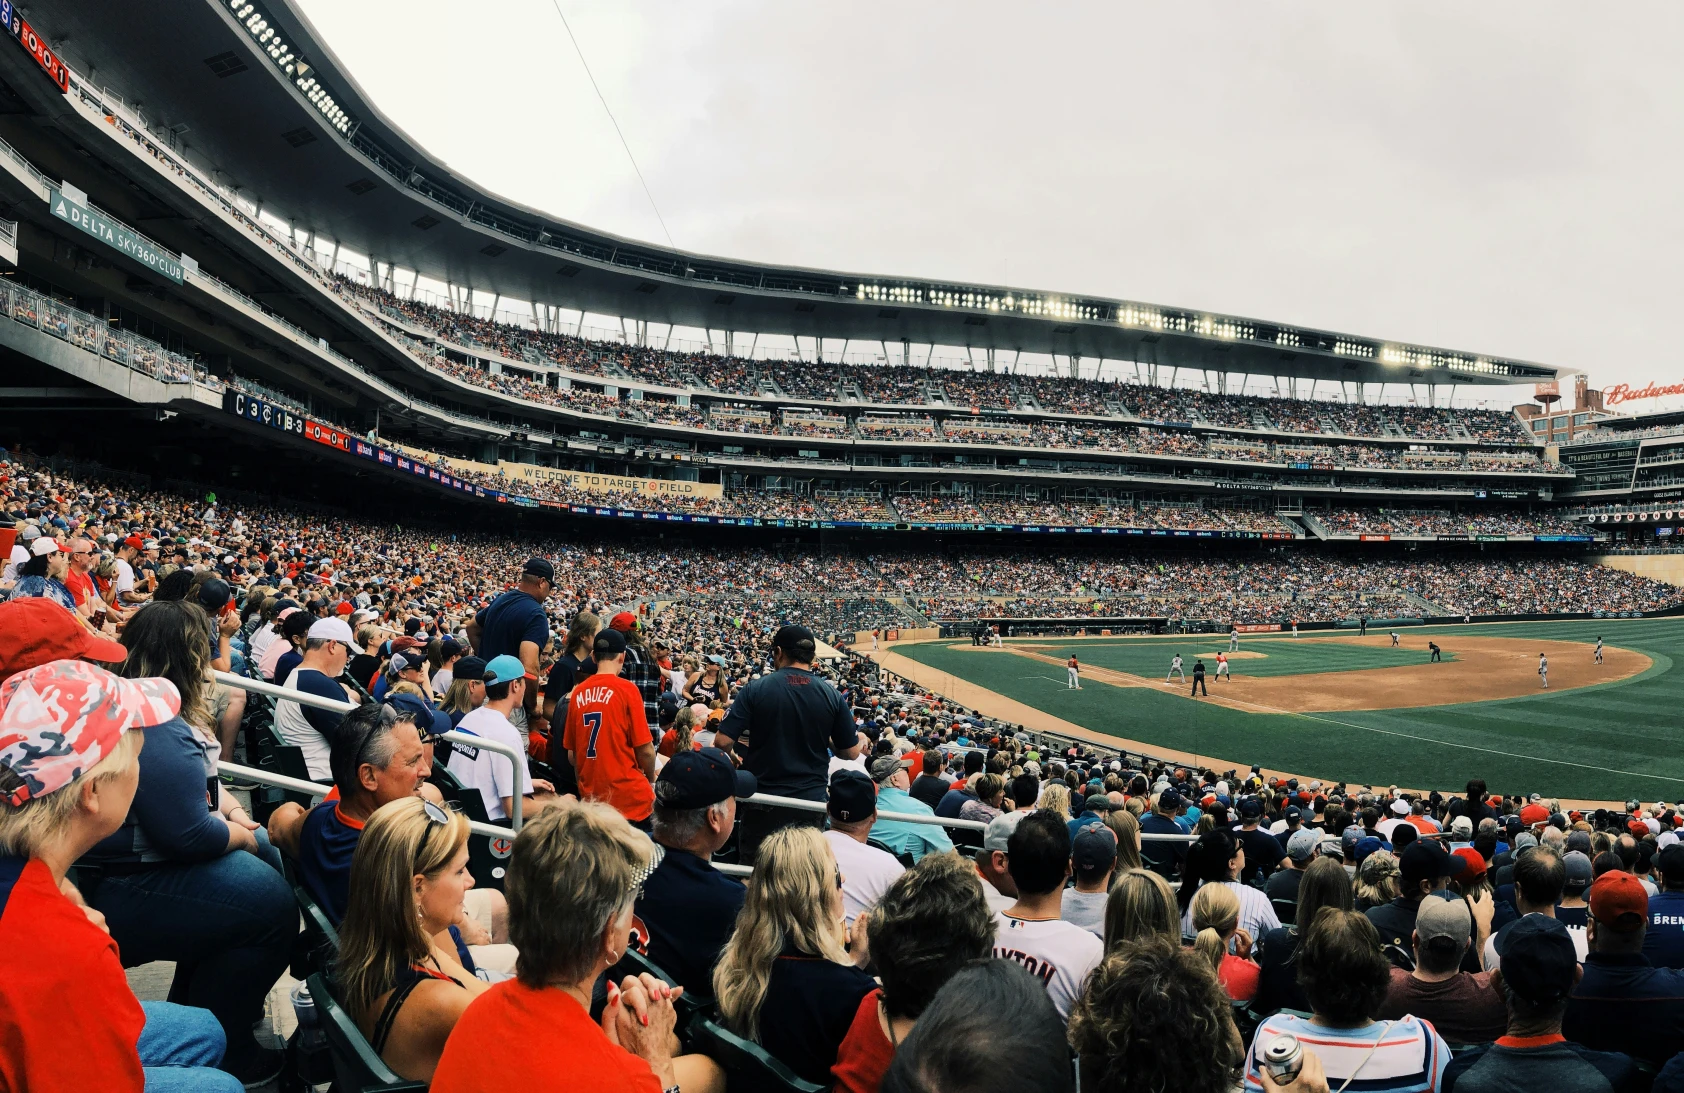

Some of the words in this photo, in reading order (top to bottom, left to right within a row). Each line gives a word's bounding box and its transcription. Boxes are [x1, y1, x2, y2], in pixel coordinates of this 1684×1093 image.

[60, 69, 64, 84] 1
[72, 207, 114, 242] DELTA
[236, 394, 244, 414] C
[251, 403, 258, 416] 3
[277, 413, 280, 425] 1
[314, 426, 320, 438] 0
[332, 433, 336, 444] 0
[344, 438, 348, 448] 1
[524, 468, 580, 483] WELCOME
[586, 476, 600, 485] TO
[602, 478, 648, 490] TARGET
[660, 482, 692, 493] FIELD
[575, 686, 614, 709] MAUER
[583, 712, 602, 758] 7
